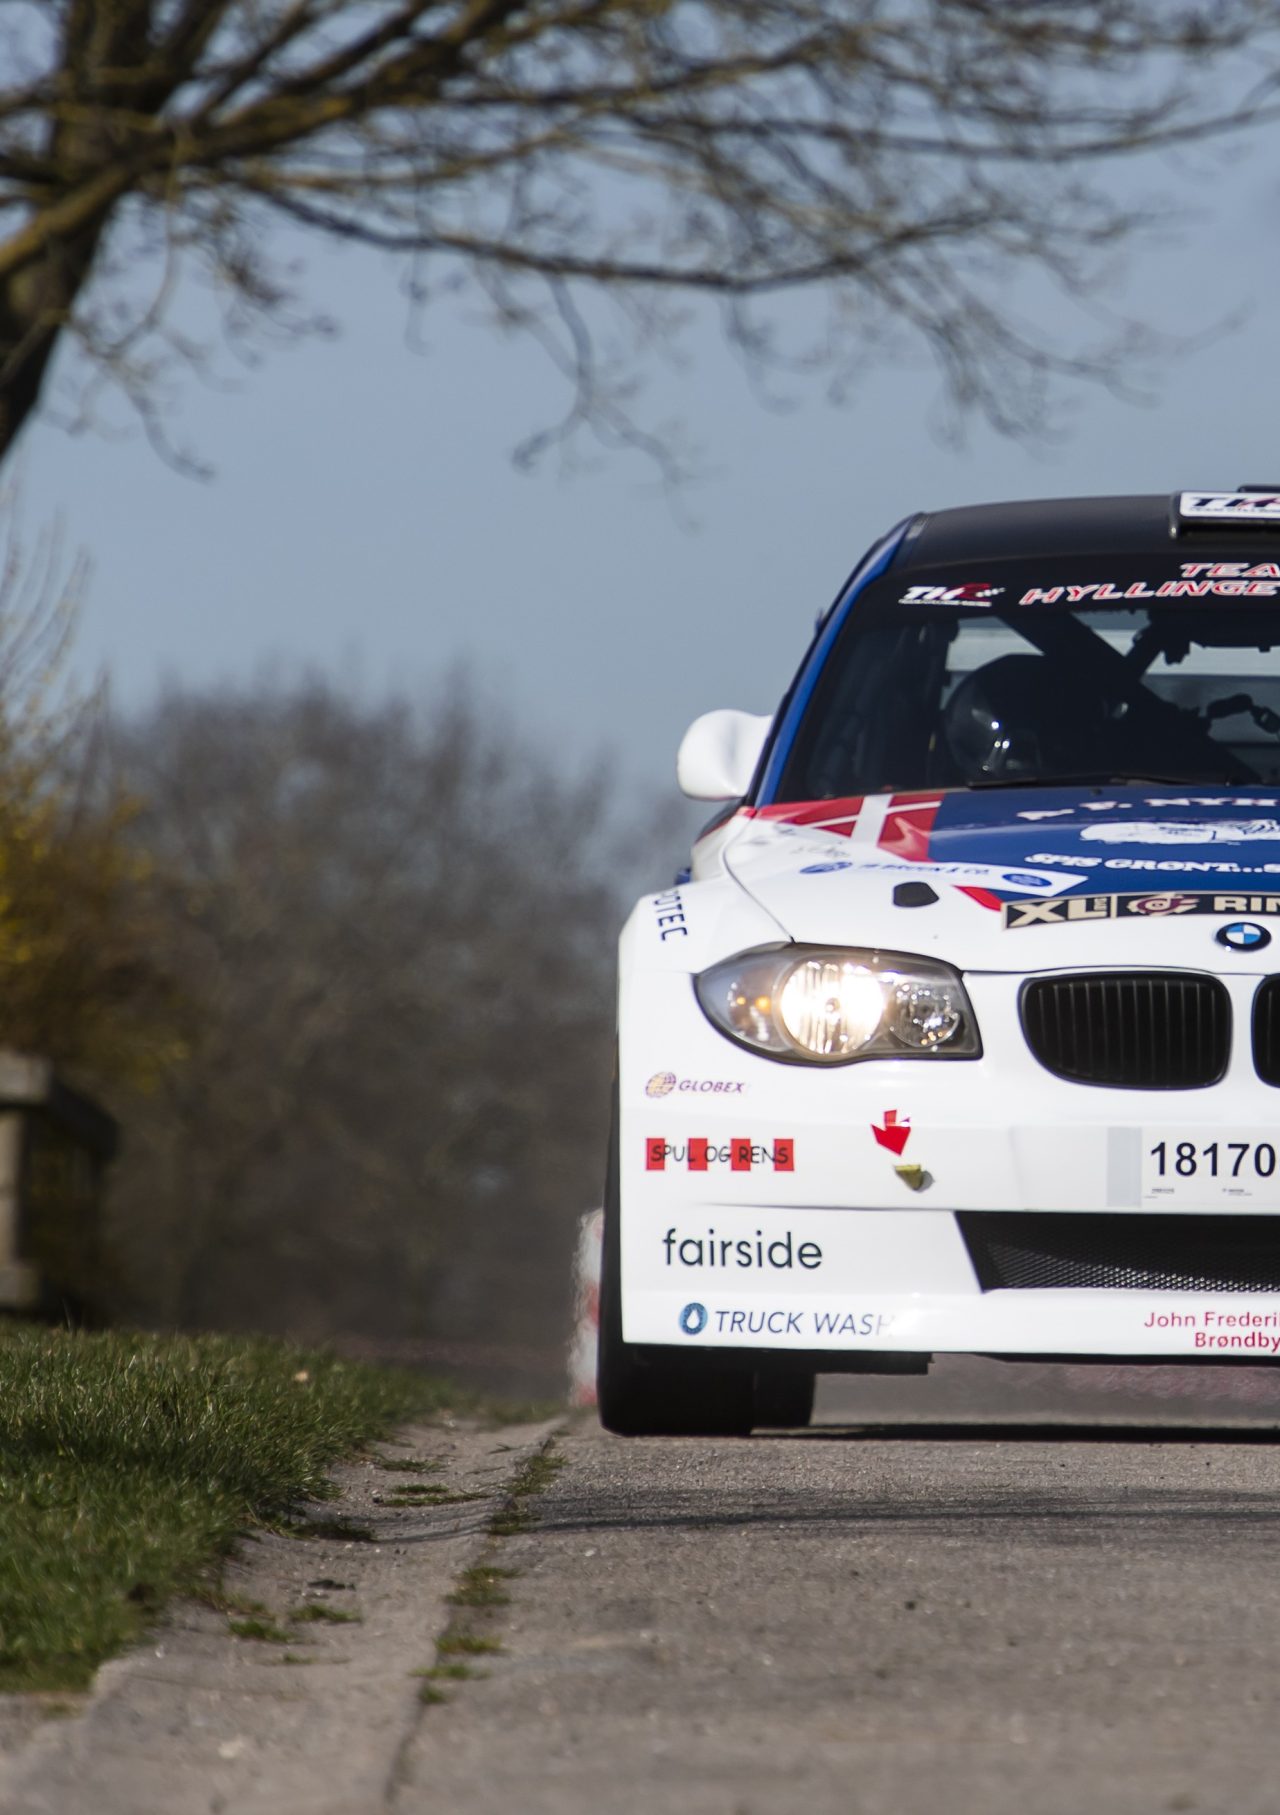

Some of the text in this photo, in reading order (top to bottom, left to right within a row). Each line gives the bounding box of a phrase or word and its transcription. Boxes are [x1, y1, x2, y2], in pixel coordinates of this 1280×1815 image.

[1025, 852, 1103, 868] SPIS
[1009, 897, 1107, 928] XL
[678, 1080, 745, 1094] GLOBEX
[650, 1145, 789, 1164] SPUL OG RENS
[662, 1228, 823, 1269] fairside
[714, 1311, 804, 1334] TRUCK
[1144, 1312, 1196, 1328] John
